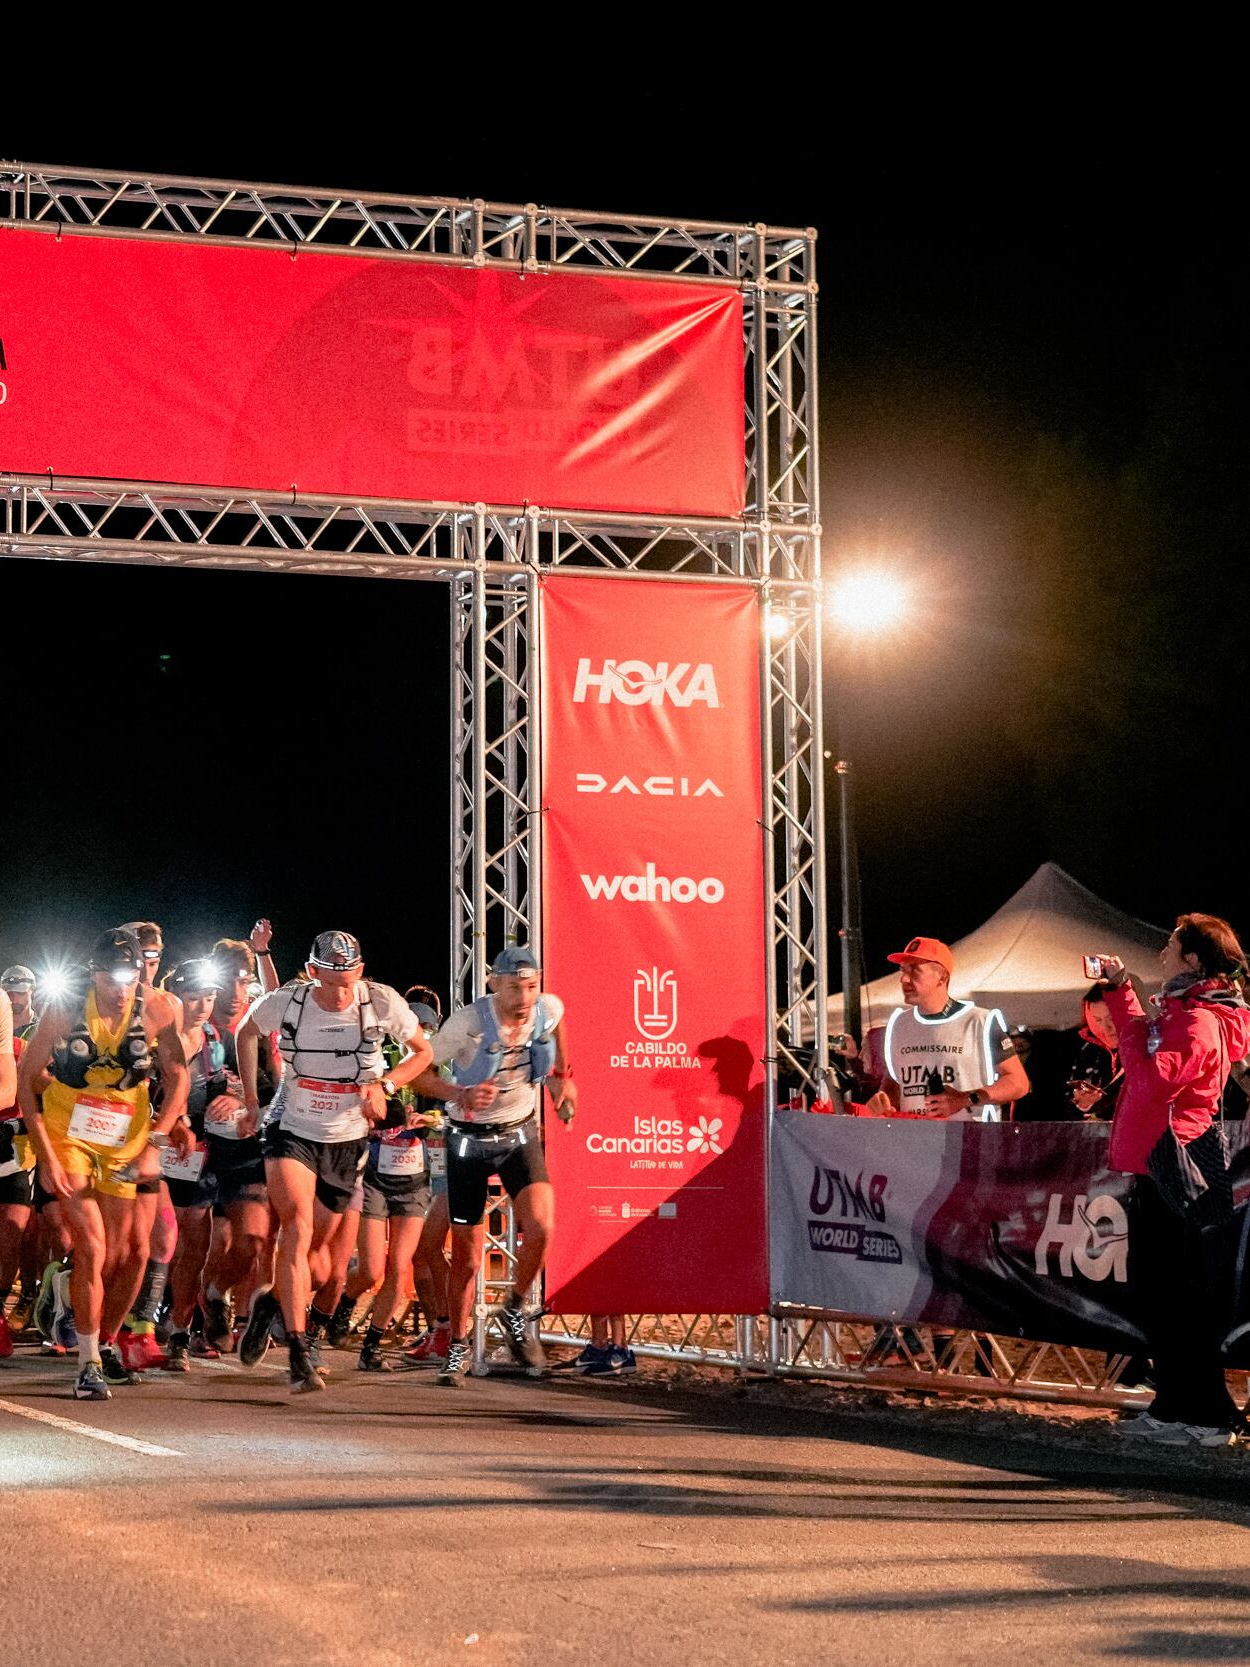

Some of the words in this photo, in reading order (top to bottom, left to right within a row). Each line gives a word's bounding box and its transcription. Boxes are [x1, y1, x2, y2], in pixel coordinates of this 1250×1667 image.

[573, 658, 720, 708] HOKA
[576, 773, 725, 797] DACIA
[580, 862, 725, 904] wahoo
[625, 1041, 687, 1055] CABILDO
[900, 1044, 963, 1055] COMMISSAIRE
[610, 1055, 629, 1067] DE
[633, 1056, 651, 1068] LA
[655, 1056, 701, 1069] PALMA
[310, 1100, 339, 1111] 2021
[634, 1116, 684, 1135] Islas
[586, 1133, 684, 1154] Canarias
[668, 1160, 684, 1169] VIDA
[809, 1165, 889, 1223] UTMB
[810, 1226, 859, 1249] WORLD
[861, 1235, 900, 1260] SERIES
